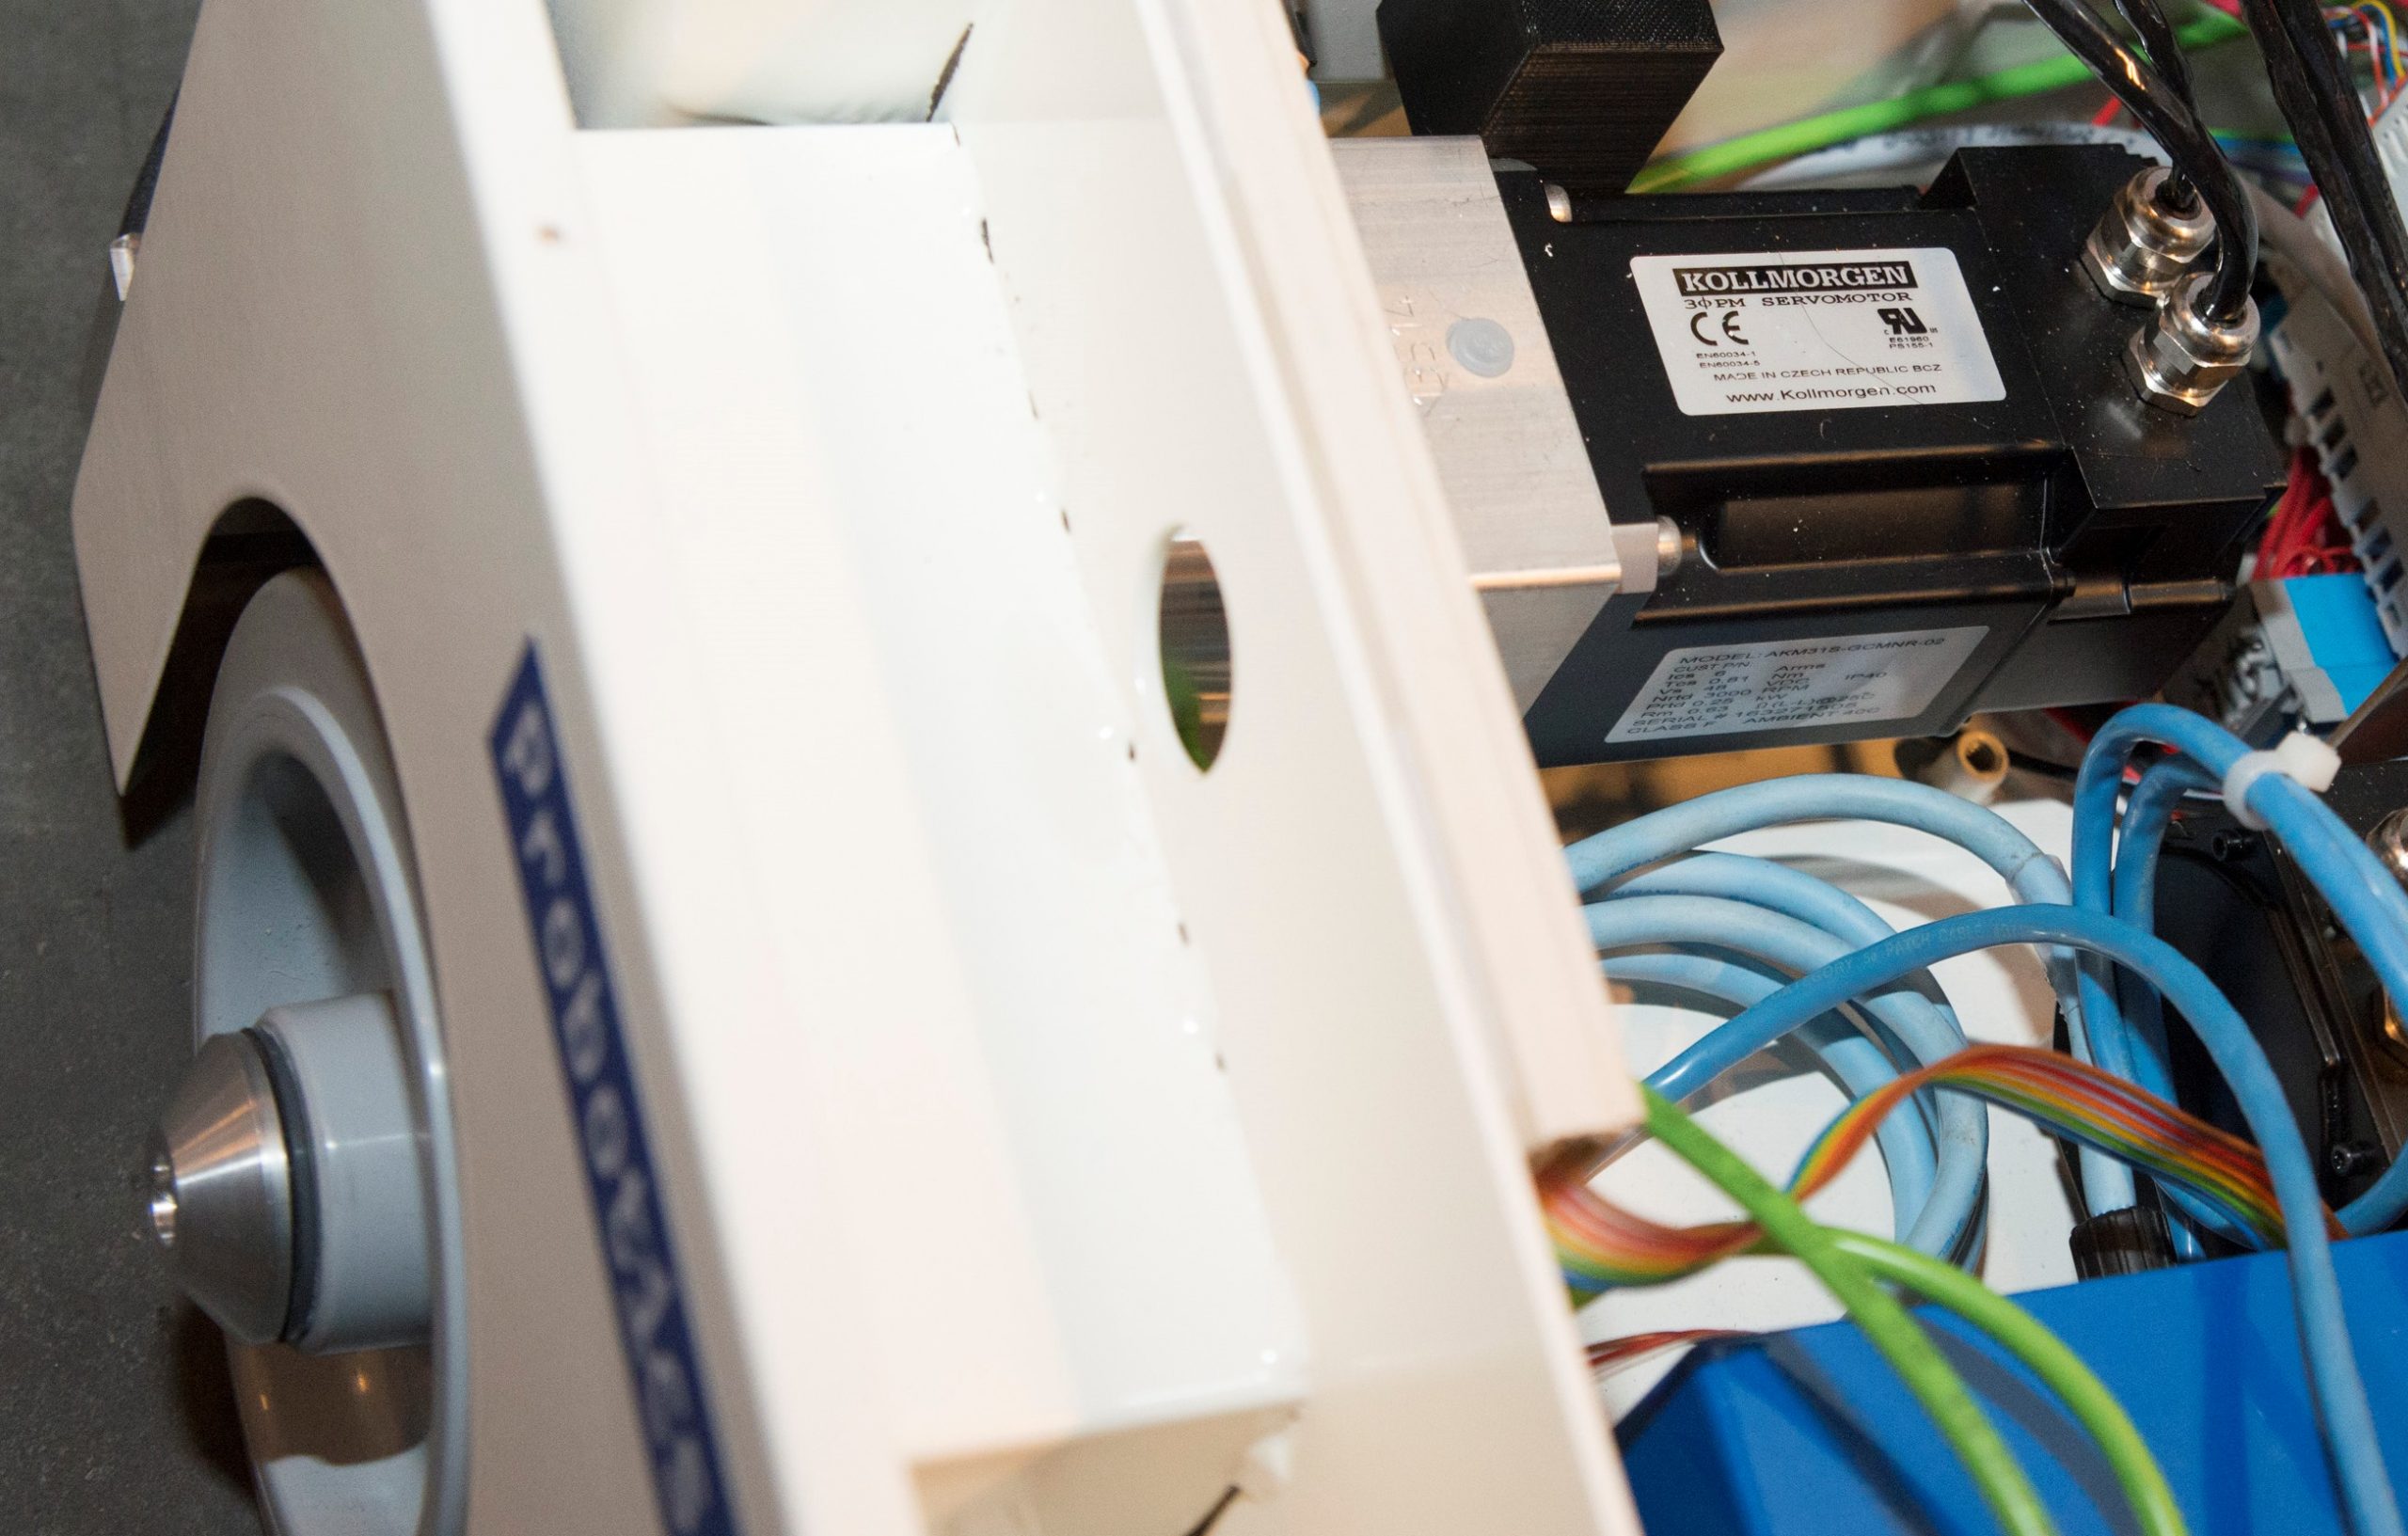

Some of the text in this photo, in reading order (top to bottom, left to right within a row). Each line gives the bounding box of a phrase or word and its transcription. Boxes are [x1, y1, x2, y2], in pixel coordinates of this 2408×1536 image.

[1681, 265, 1909, 293] KOLLMORGEN
[1762, 292, 1913, 307] SERVOMOTOR
[1696, 351, 1756, 360] EN60034-1
[1714, 363, 1942, 382] MADE IN CZECH REPUBLIC BCZ
[1726, 384, 1938, 404] www.Kollmorgen.com
